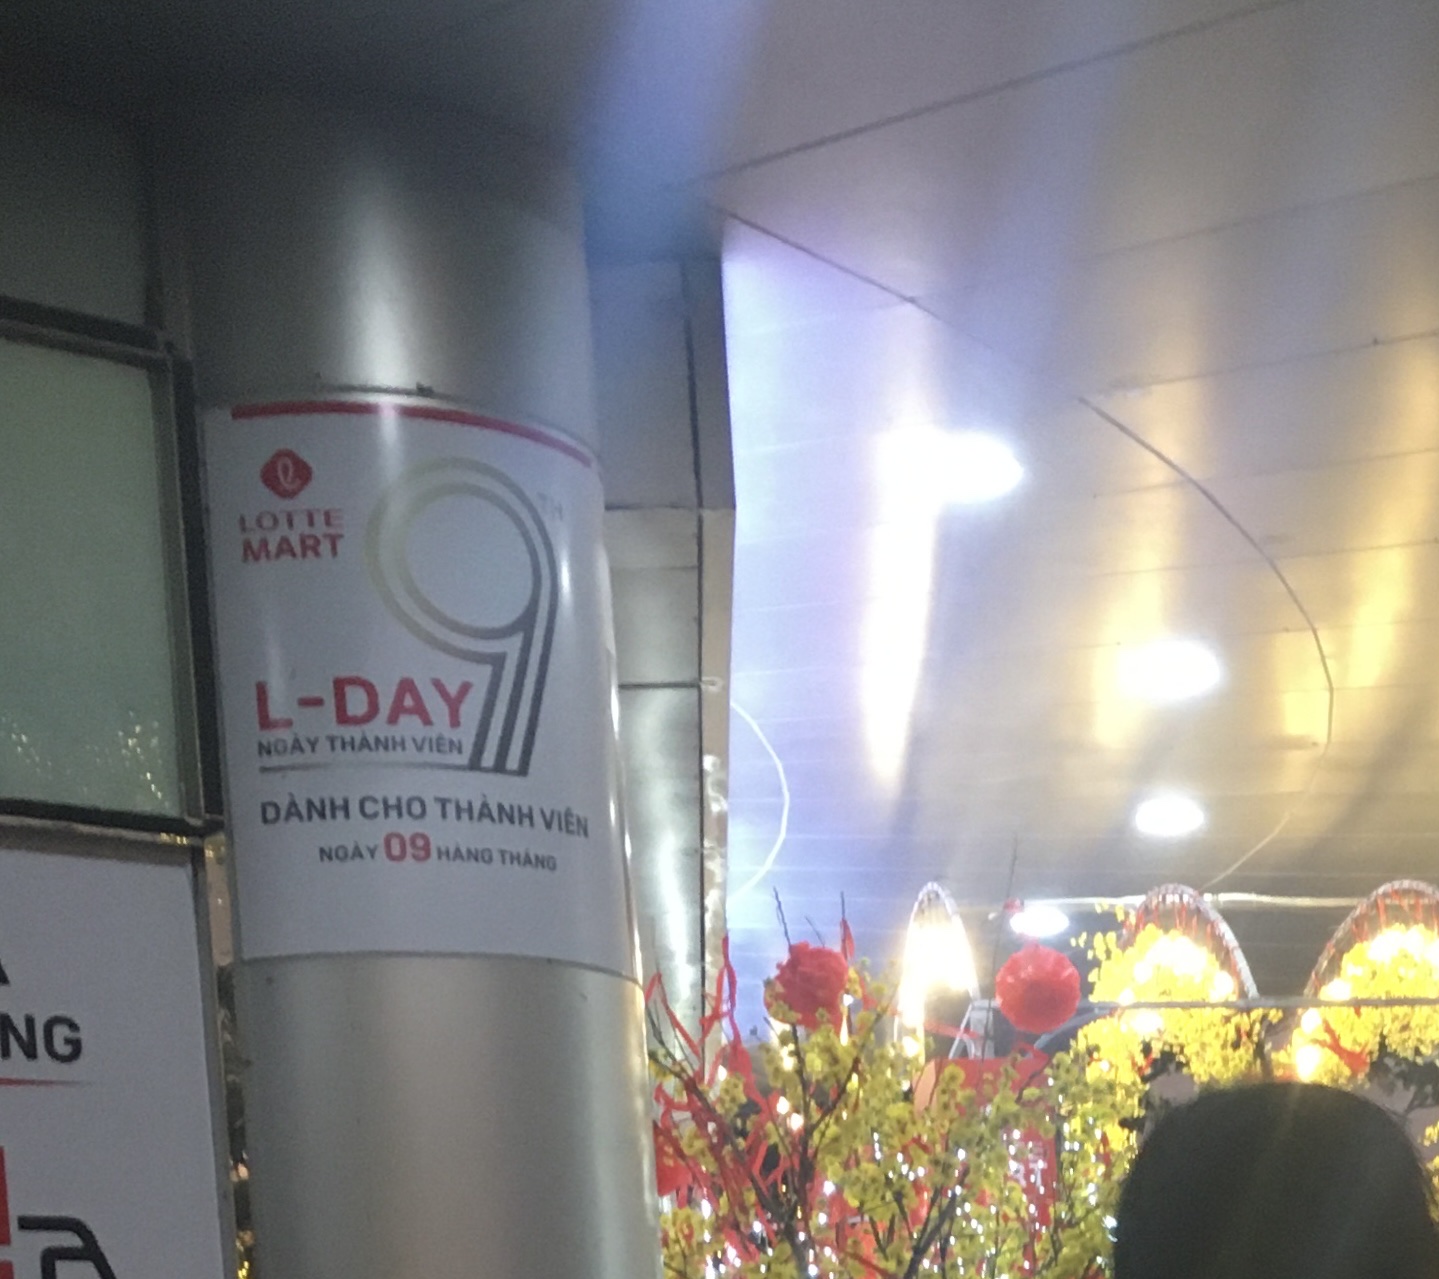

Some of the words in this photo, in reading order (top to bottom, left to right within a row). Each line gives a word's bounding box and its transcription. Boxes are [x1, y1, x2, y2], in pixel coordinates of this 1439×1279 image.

[239, 508, 344, 533] LOTTE
[242, 533, 344, 563] MART
[256, 675, 474, 732] L-DAY
[257, 733, 320, 758] NGÀY
[325, 730, 406, 753] THÀNH
[411, 732, 464, 755] VIÊN
[260, 791, 350, 825] DÀNH
[358, 795, 427, 821] CHO
[433, 793, 534, 829] THÀNH
[539, 806, 590, 839] VIÊN
[318, 840, 379, 863] NGÀY
[383, 831, 433, 863] 09
[436, 842, 494, 866] HÀNG
